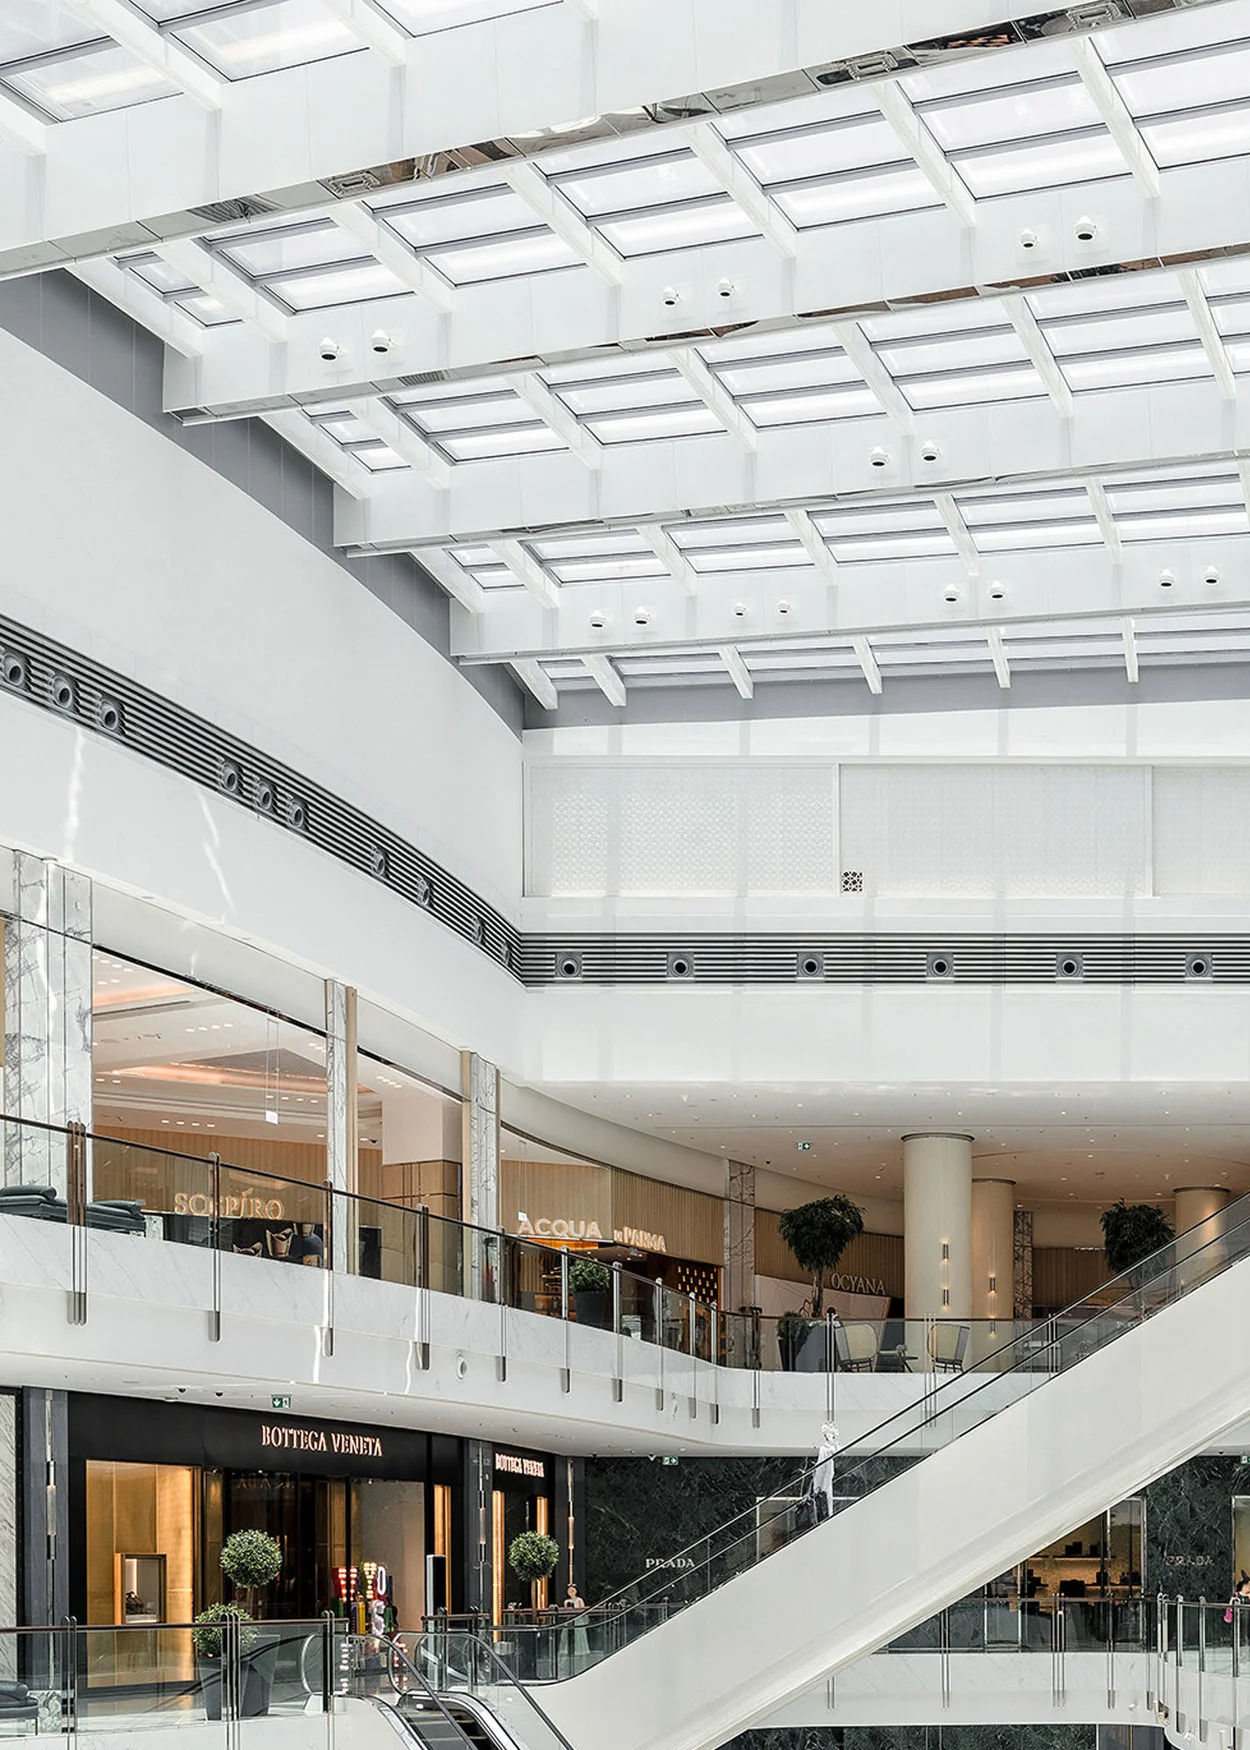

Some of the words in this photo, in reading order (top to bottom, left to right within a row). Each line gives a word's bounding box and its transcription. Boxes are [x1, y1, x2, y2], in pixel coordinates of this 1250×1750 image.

[517, 1217, 603, 1239] ACQUA
[623, 1226, 667, 1252] PARMA
[261, 1424, 328, 1452] BOTTEGA
[330, 1432, 383, 1457] VENETA
[495, 1452, 522, 1474] BOTTEGA
[523, 1458, 545, 1478] VENETA
[645, 1558, 696, 1569] PRADA
